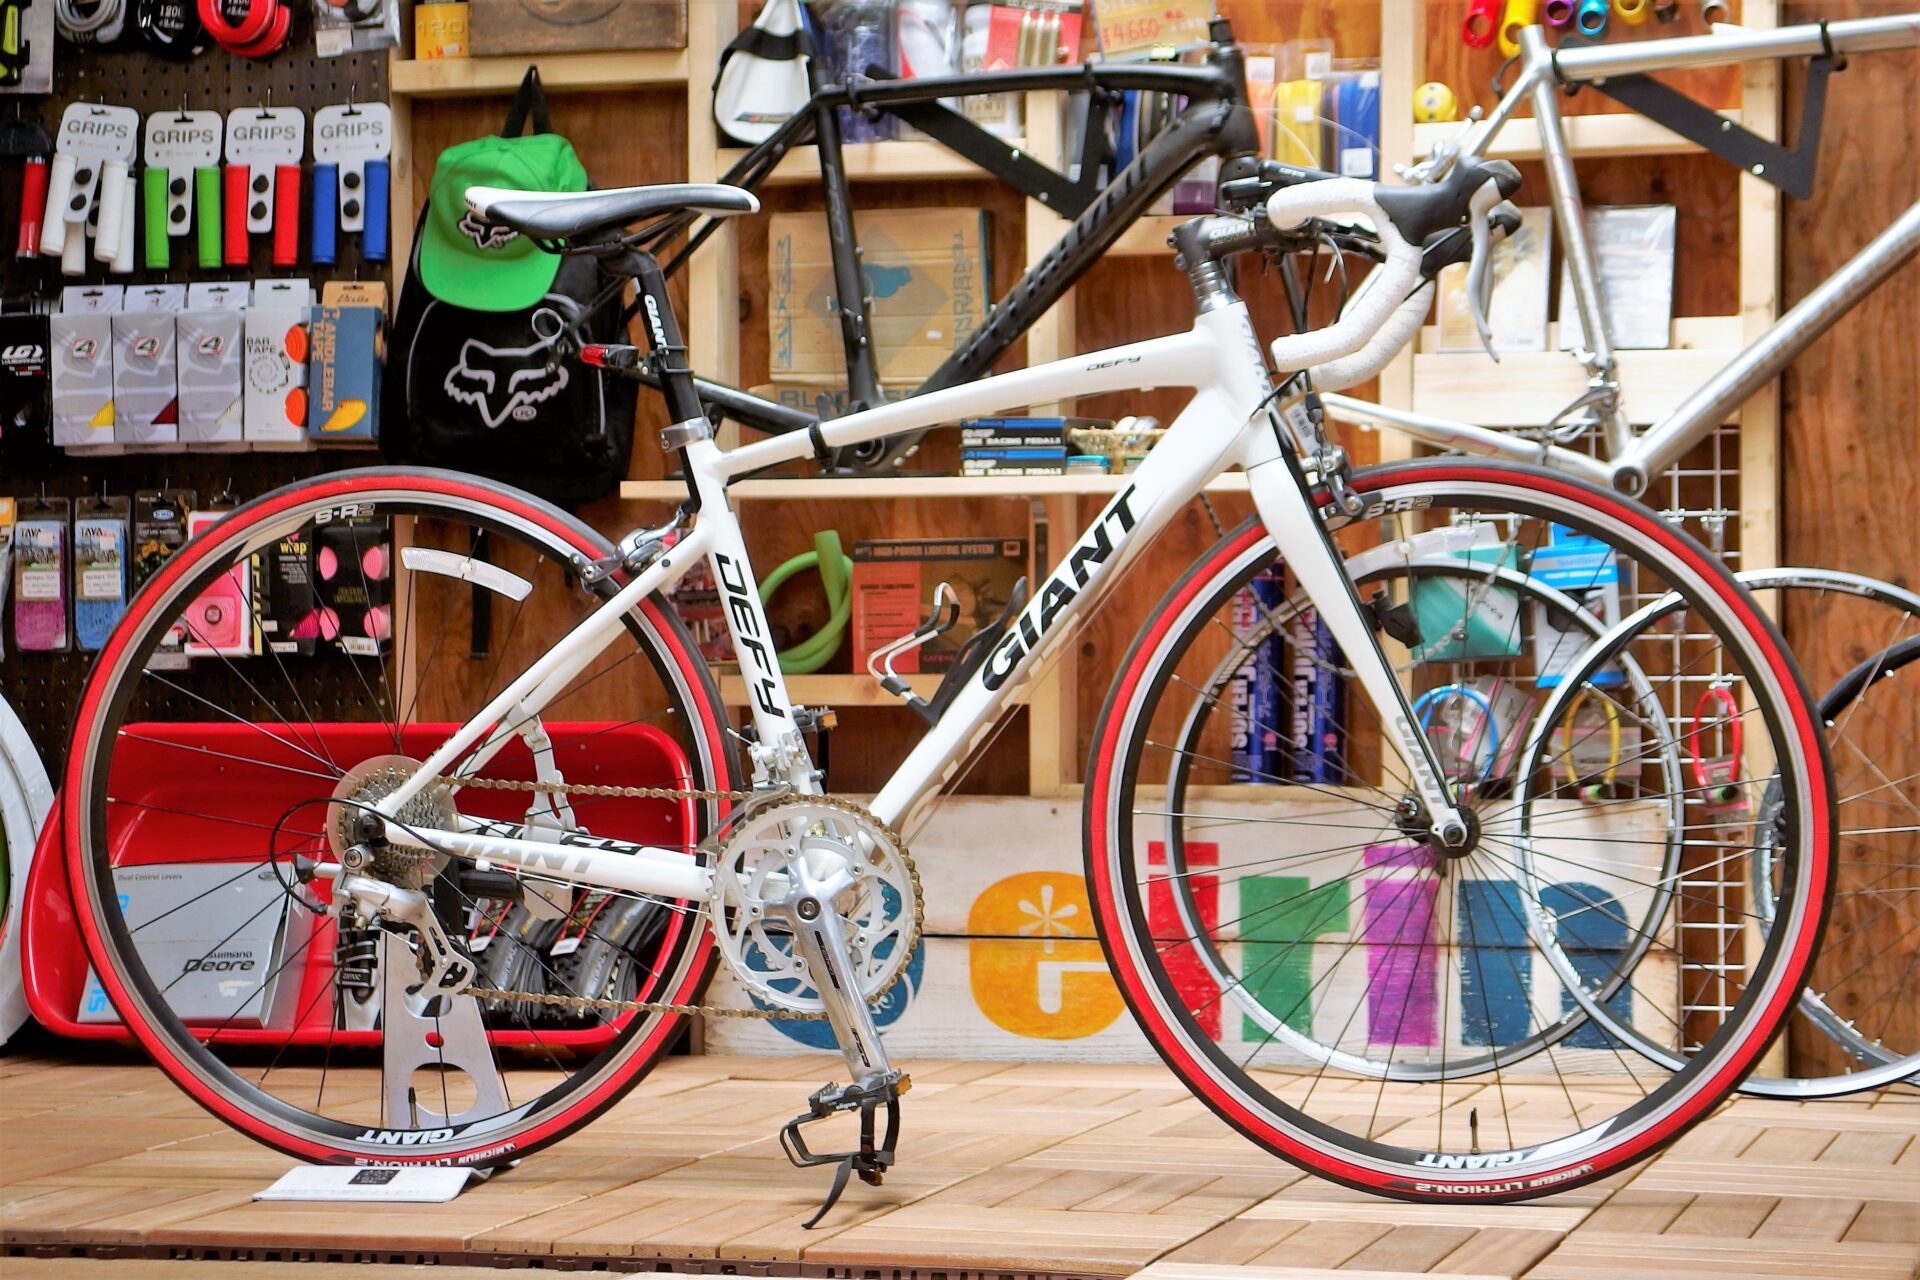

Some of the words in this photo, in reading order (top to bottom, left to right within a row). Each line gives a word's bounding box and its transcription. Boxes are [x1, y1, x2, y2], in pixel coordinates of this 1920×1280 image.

[67, 120, 128, 138] GRIPS
[152, 129, 214, 144] GRIPS
[234, 126, 296, 140] GRIPS
[320, 121, 384, 139] GRIPS
[644, 294, 670, 355] GIANT
[246, 337, 270, 345] BAR
[311, 322, 324, 361] TAPE
[248, 345, 276, 354] TAPE
[1086, 355, 1142, 371] DEFY
[986, 437, 1022, 446] RACING
[1025, 437, 1062, 445] PEDALS
[987, 468, 1023, 476] RACING
[1025, 467, 1062, 475] PEDALS
[924, 545, 960, 556] LIGHTING
[961, 544, 995, 555] SYSTEM
[983, 483, 1138, 692] GIANT
[714, 551, 786, 719] DEFY
[1231, 680, 1248, 748] SUPER
[182, 959, 256, 973] Deore
[356, 1129, 454, 1145] GIANT
[458, 1147, 505, 1164] MICHELIN
[1415, 1151, 1526, 1169] GIANT
[1530, 1167, 1583, 1188] MICHELIN
[1415, 1181, 1524, 1194] LITHION.2
